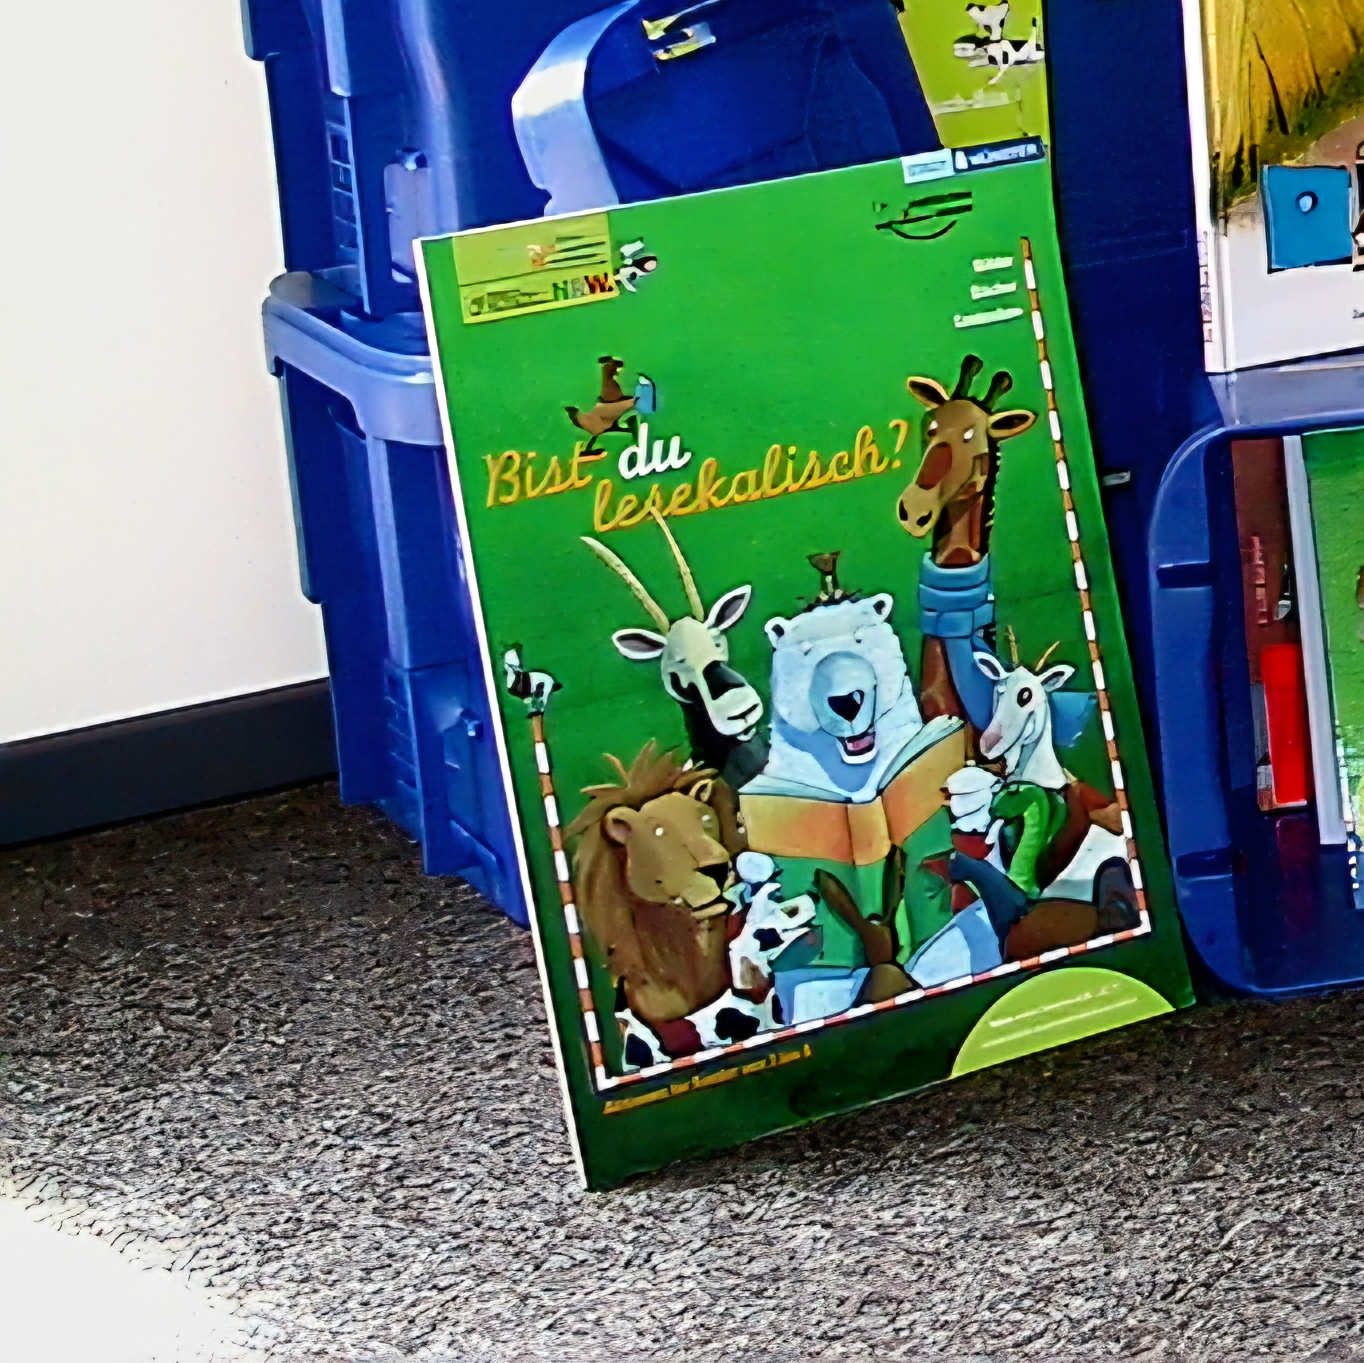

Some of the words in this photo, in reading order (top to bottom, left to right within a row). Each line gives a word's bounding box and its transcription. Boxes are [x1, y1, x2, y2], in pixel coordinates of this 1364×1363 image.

[482, 440, 608, 509] Bist
[616, 421, 693, 480] du
[593, 419, 909, 533] lesekalisch?
